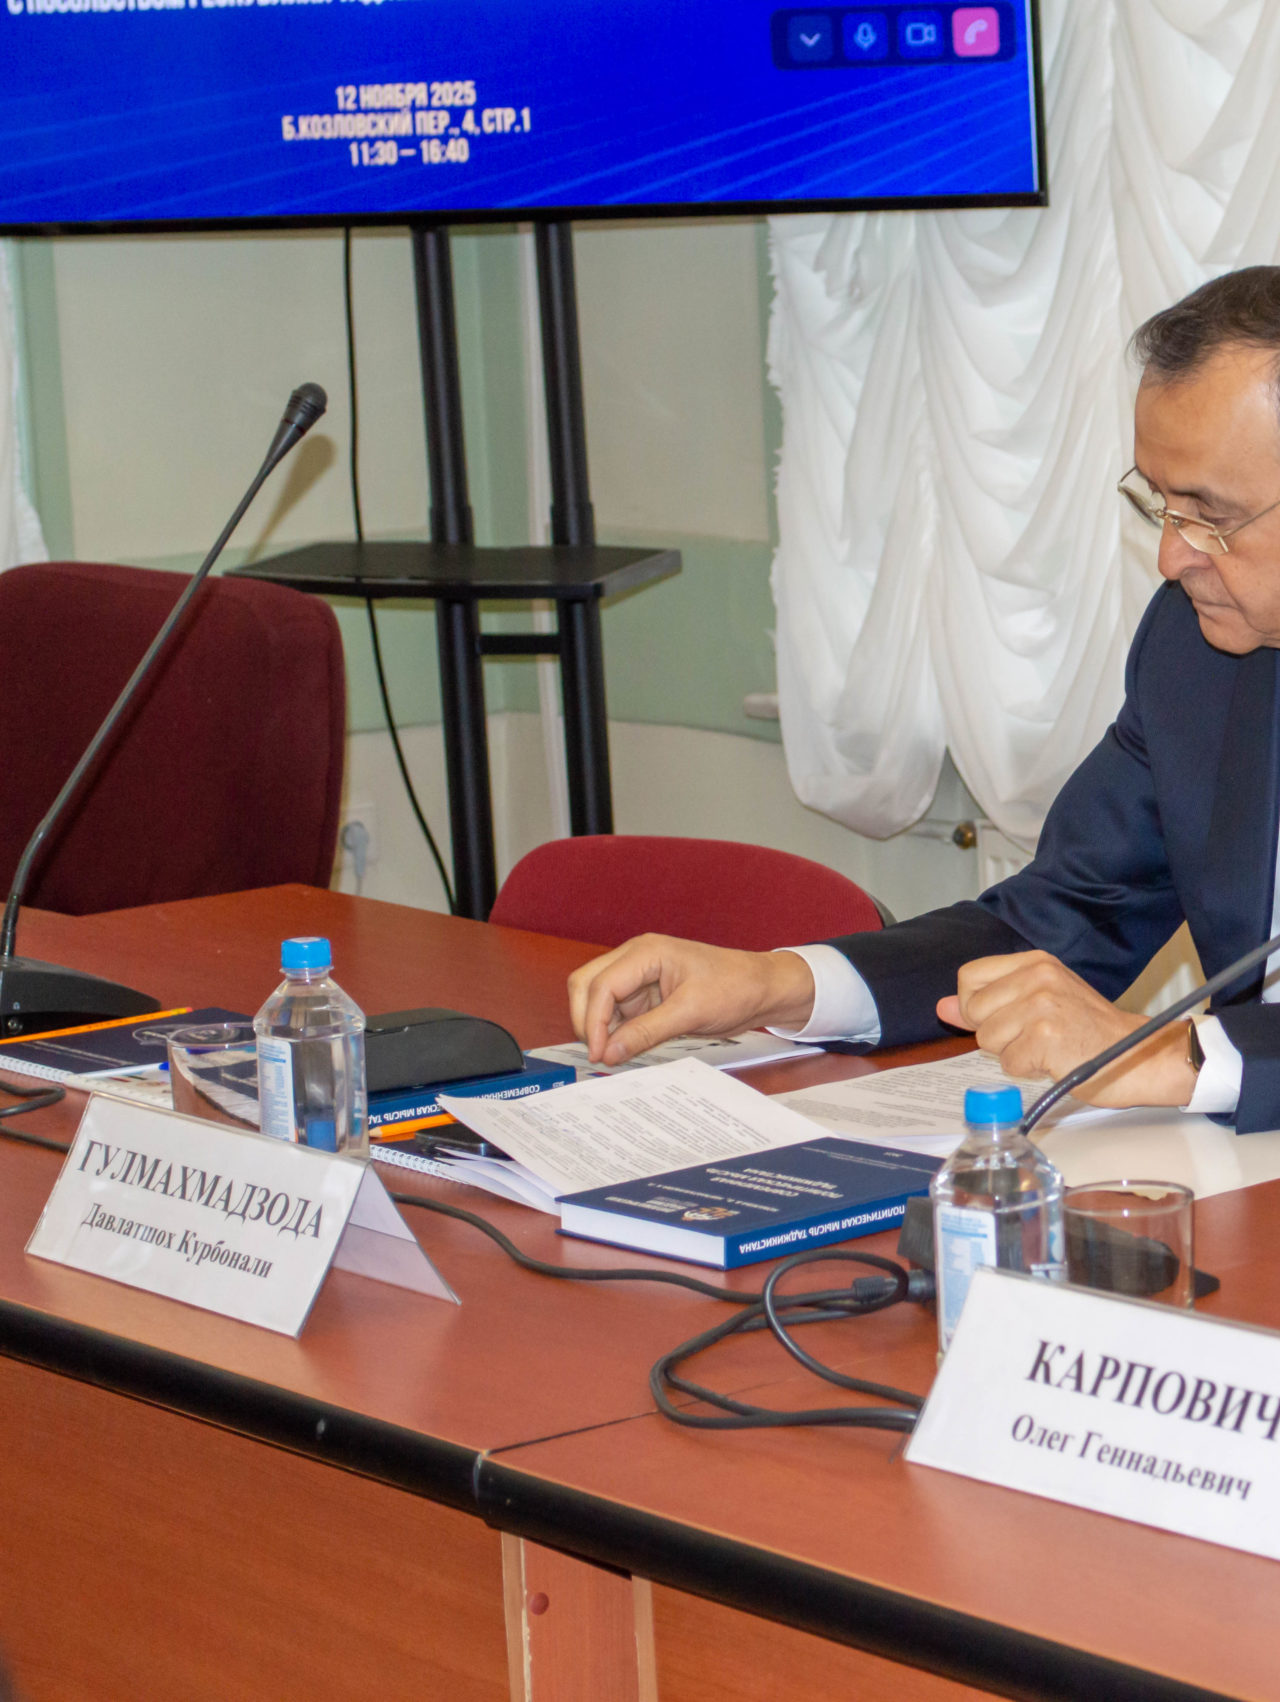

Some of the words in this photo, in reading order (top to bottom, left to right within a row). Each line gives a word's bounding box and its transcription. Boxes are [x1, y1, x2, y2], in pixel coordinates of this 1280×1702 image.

[336, 85, 357, 110] 12
[359, 83, 428, 108] НОЯБРЯ
[430, 80, 476, 107] 2025
[282, 110, 413, 140] Б.КОЗЛОВСКИЙ
[462, 109, 481, 136] 4,
[482, 107, 530, 133] СТР.1
[349, 140, 398, 166] 11:30
[420, 138, 469, 164] 16:40
[77, 1139, 324, 1241] ГУЛМАХМАДЗОДА
[808, 1220, 840, 1237] МЫСЛЬ
[841, 1204, 905, 1229] ПОЛИТИЧЕСКАЯ
[81, 1202, 176, 1249] Давлатшох
[176, 1229, 273, 1278] Курбонали
[739, 1229, 807, 1254] ТАДЖИКИСТАНА
[1011, 1414, 1074, 1453] Олег
[1078, 1430, 1253, 1501] Геннадьевич
